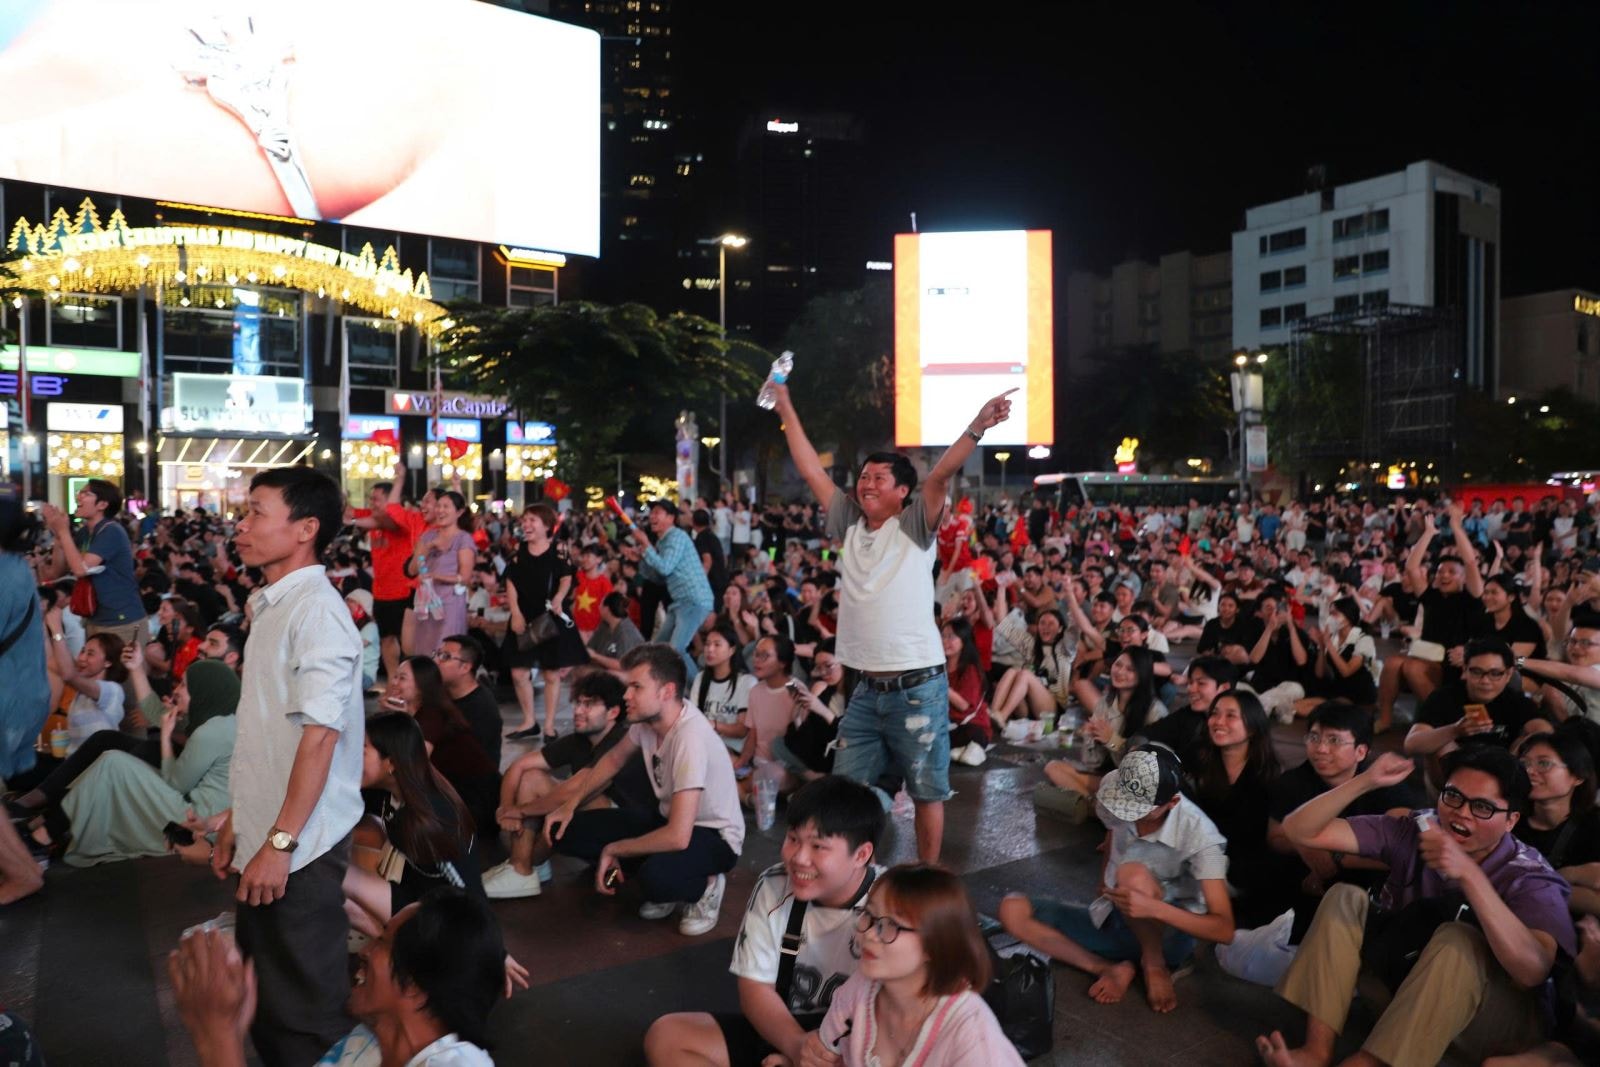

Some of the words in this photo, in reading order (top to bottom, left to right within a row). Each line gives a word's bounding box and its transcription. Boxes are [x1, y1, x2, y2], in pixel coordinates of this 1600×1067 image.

[123, 227, 219, 249] CHRISTMAS
[221, 228, 255, 249] AND
[254, 233, 309, 259] HAPPY
[411, 395, 512, 418] ViaCapita
